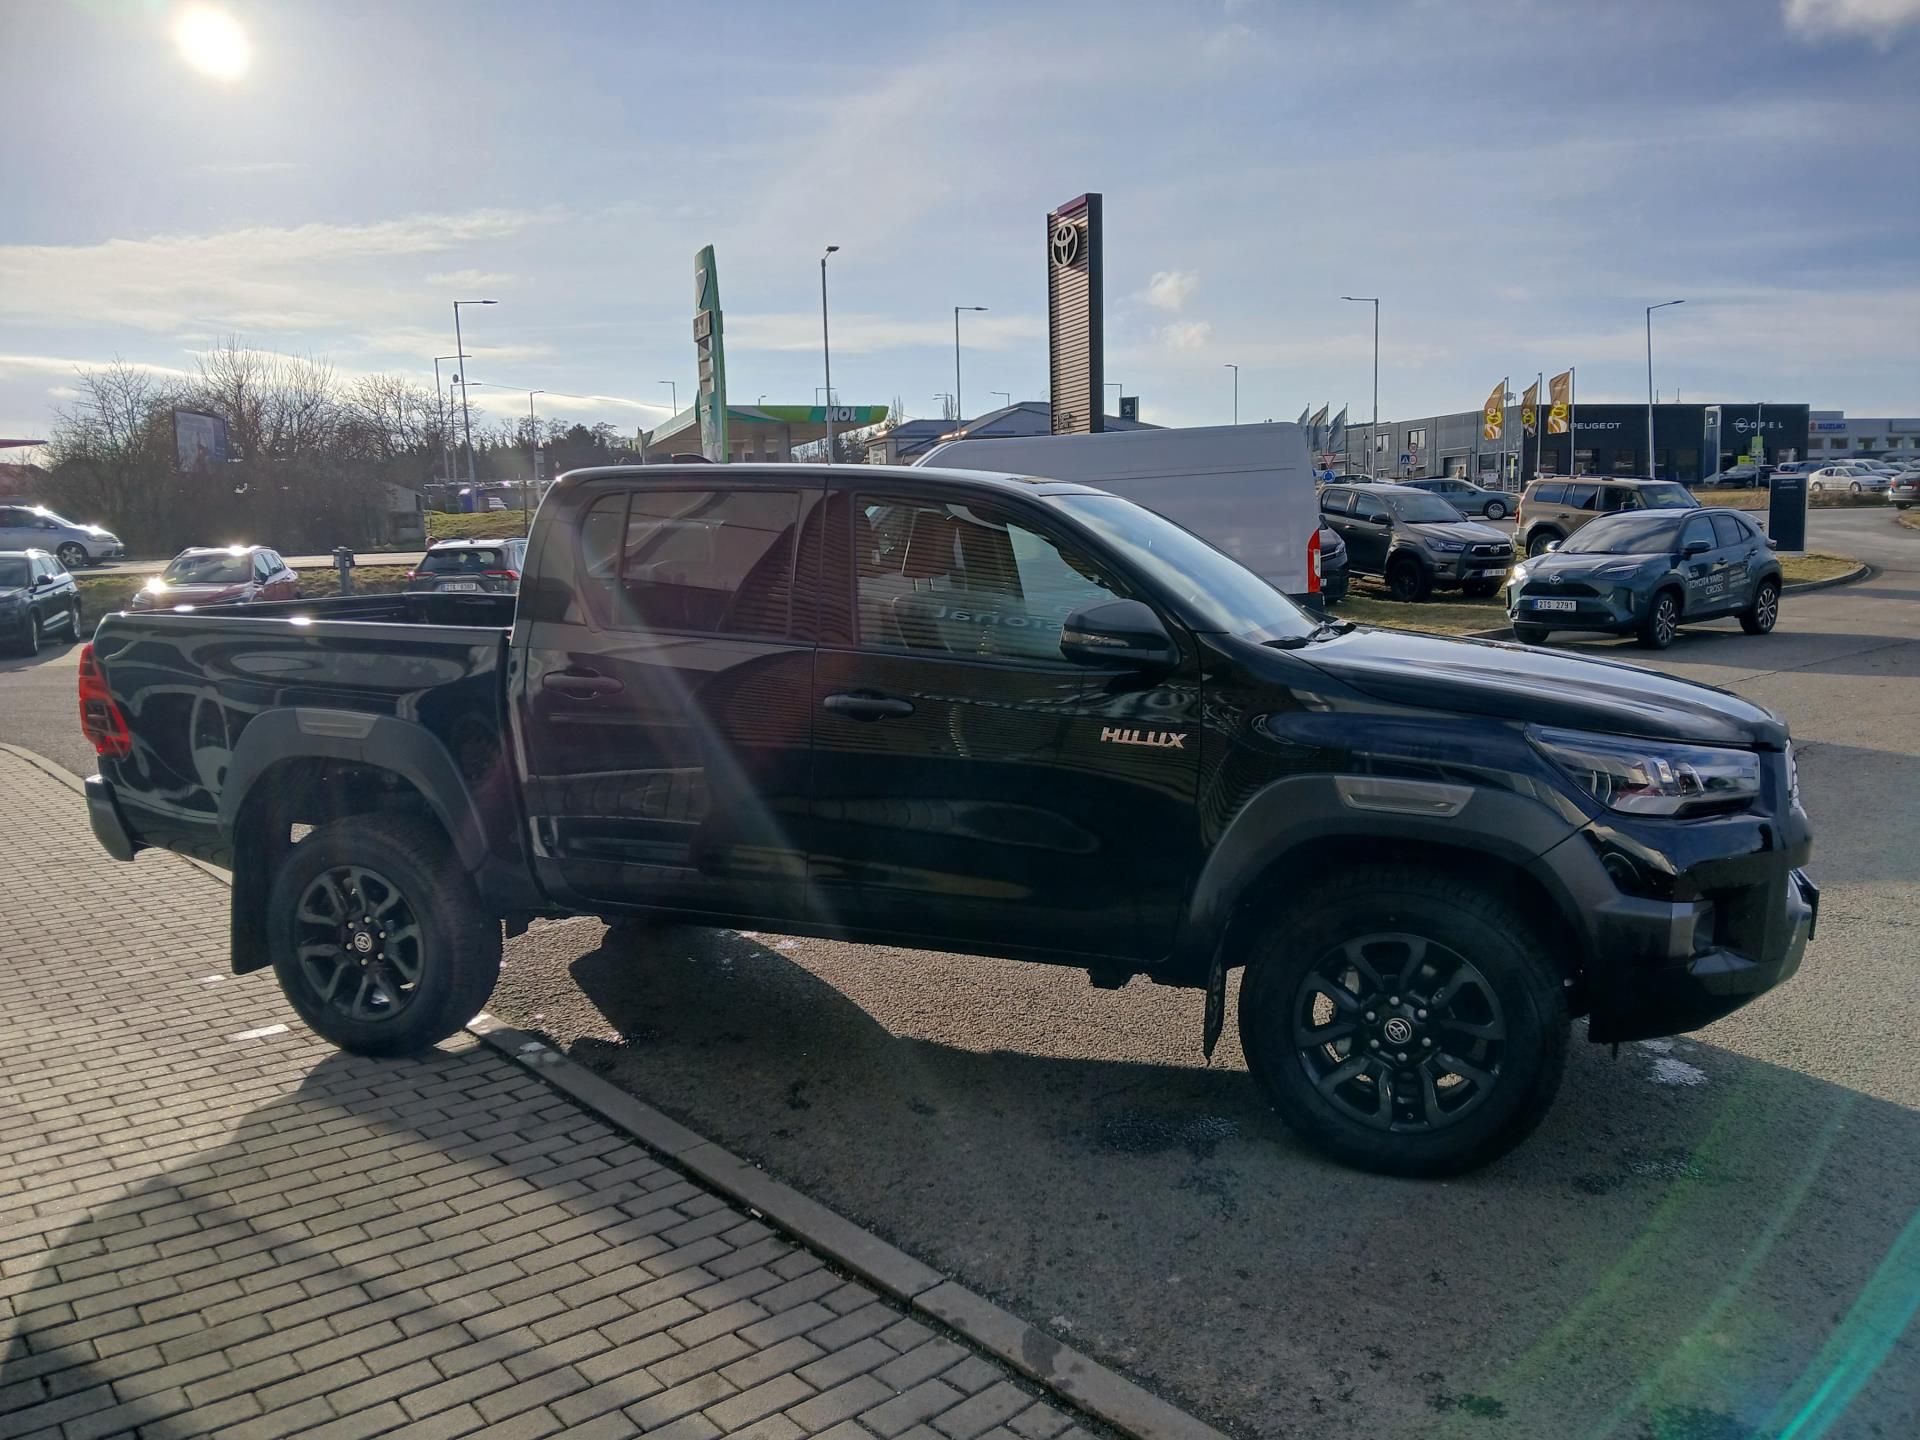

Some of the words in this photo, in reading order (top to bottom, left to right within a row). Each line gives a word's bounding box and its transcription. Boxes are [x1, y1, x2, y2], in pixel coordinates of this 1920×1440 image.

[824, 407, 856, 421] MOL
[1570, 422, 1621, 430] PEUGEOT
[1750, 421, 1784, 429] OPEL
[1705, 583, 1724, 595] CROSS
[1539, 601, 1551, 609] 2TS
[1100, 727, 1188, 749] HILUX
